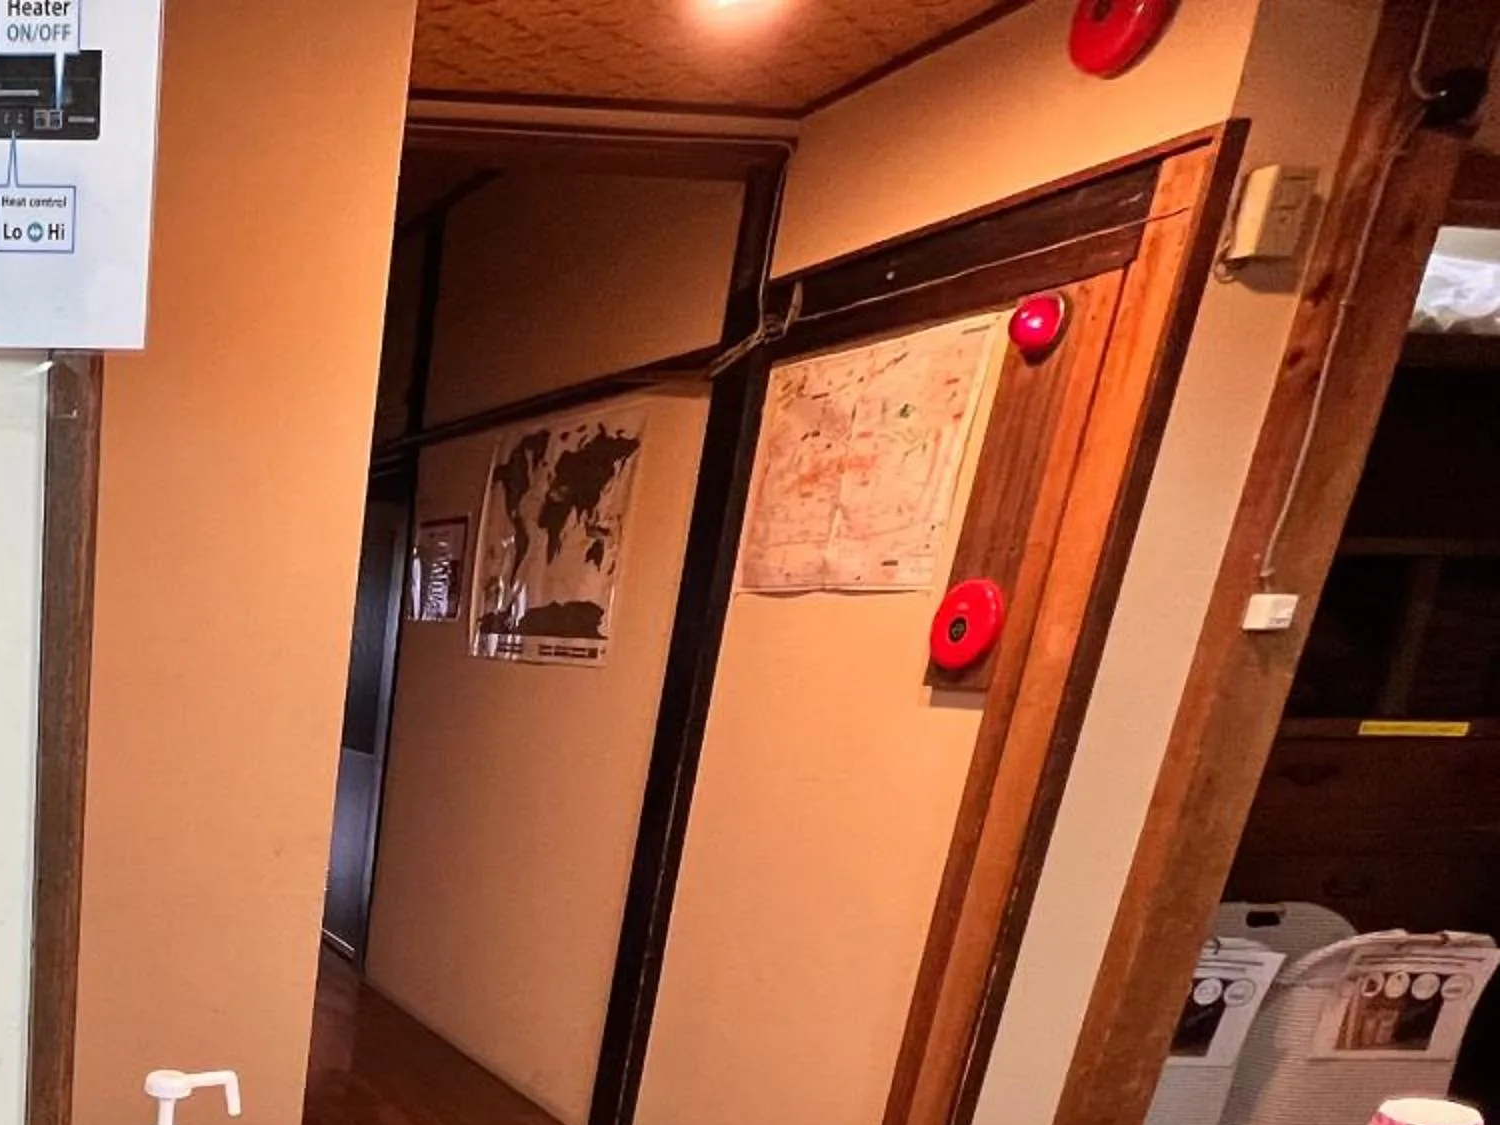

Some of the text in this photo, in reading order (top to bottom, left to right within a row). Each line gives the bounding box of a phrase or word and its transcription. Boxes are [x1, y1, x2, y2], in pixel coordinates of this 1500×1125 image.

[7, 0, 70, 16] Heater
[7, 24, 71, 41] ON/OFF
[1, 196, 67, 208] Heat control
[3, 223, 65, 240] Lo Hi
